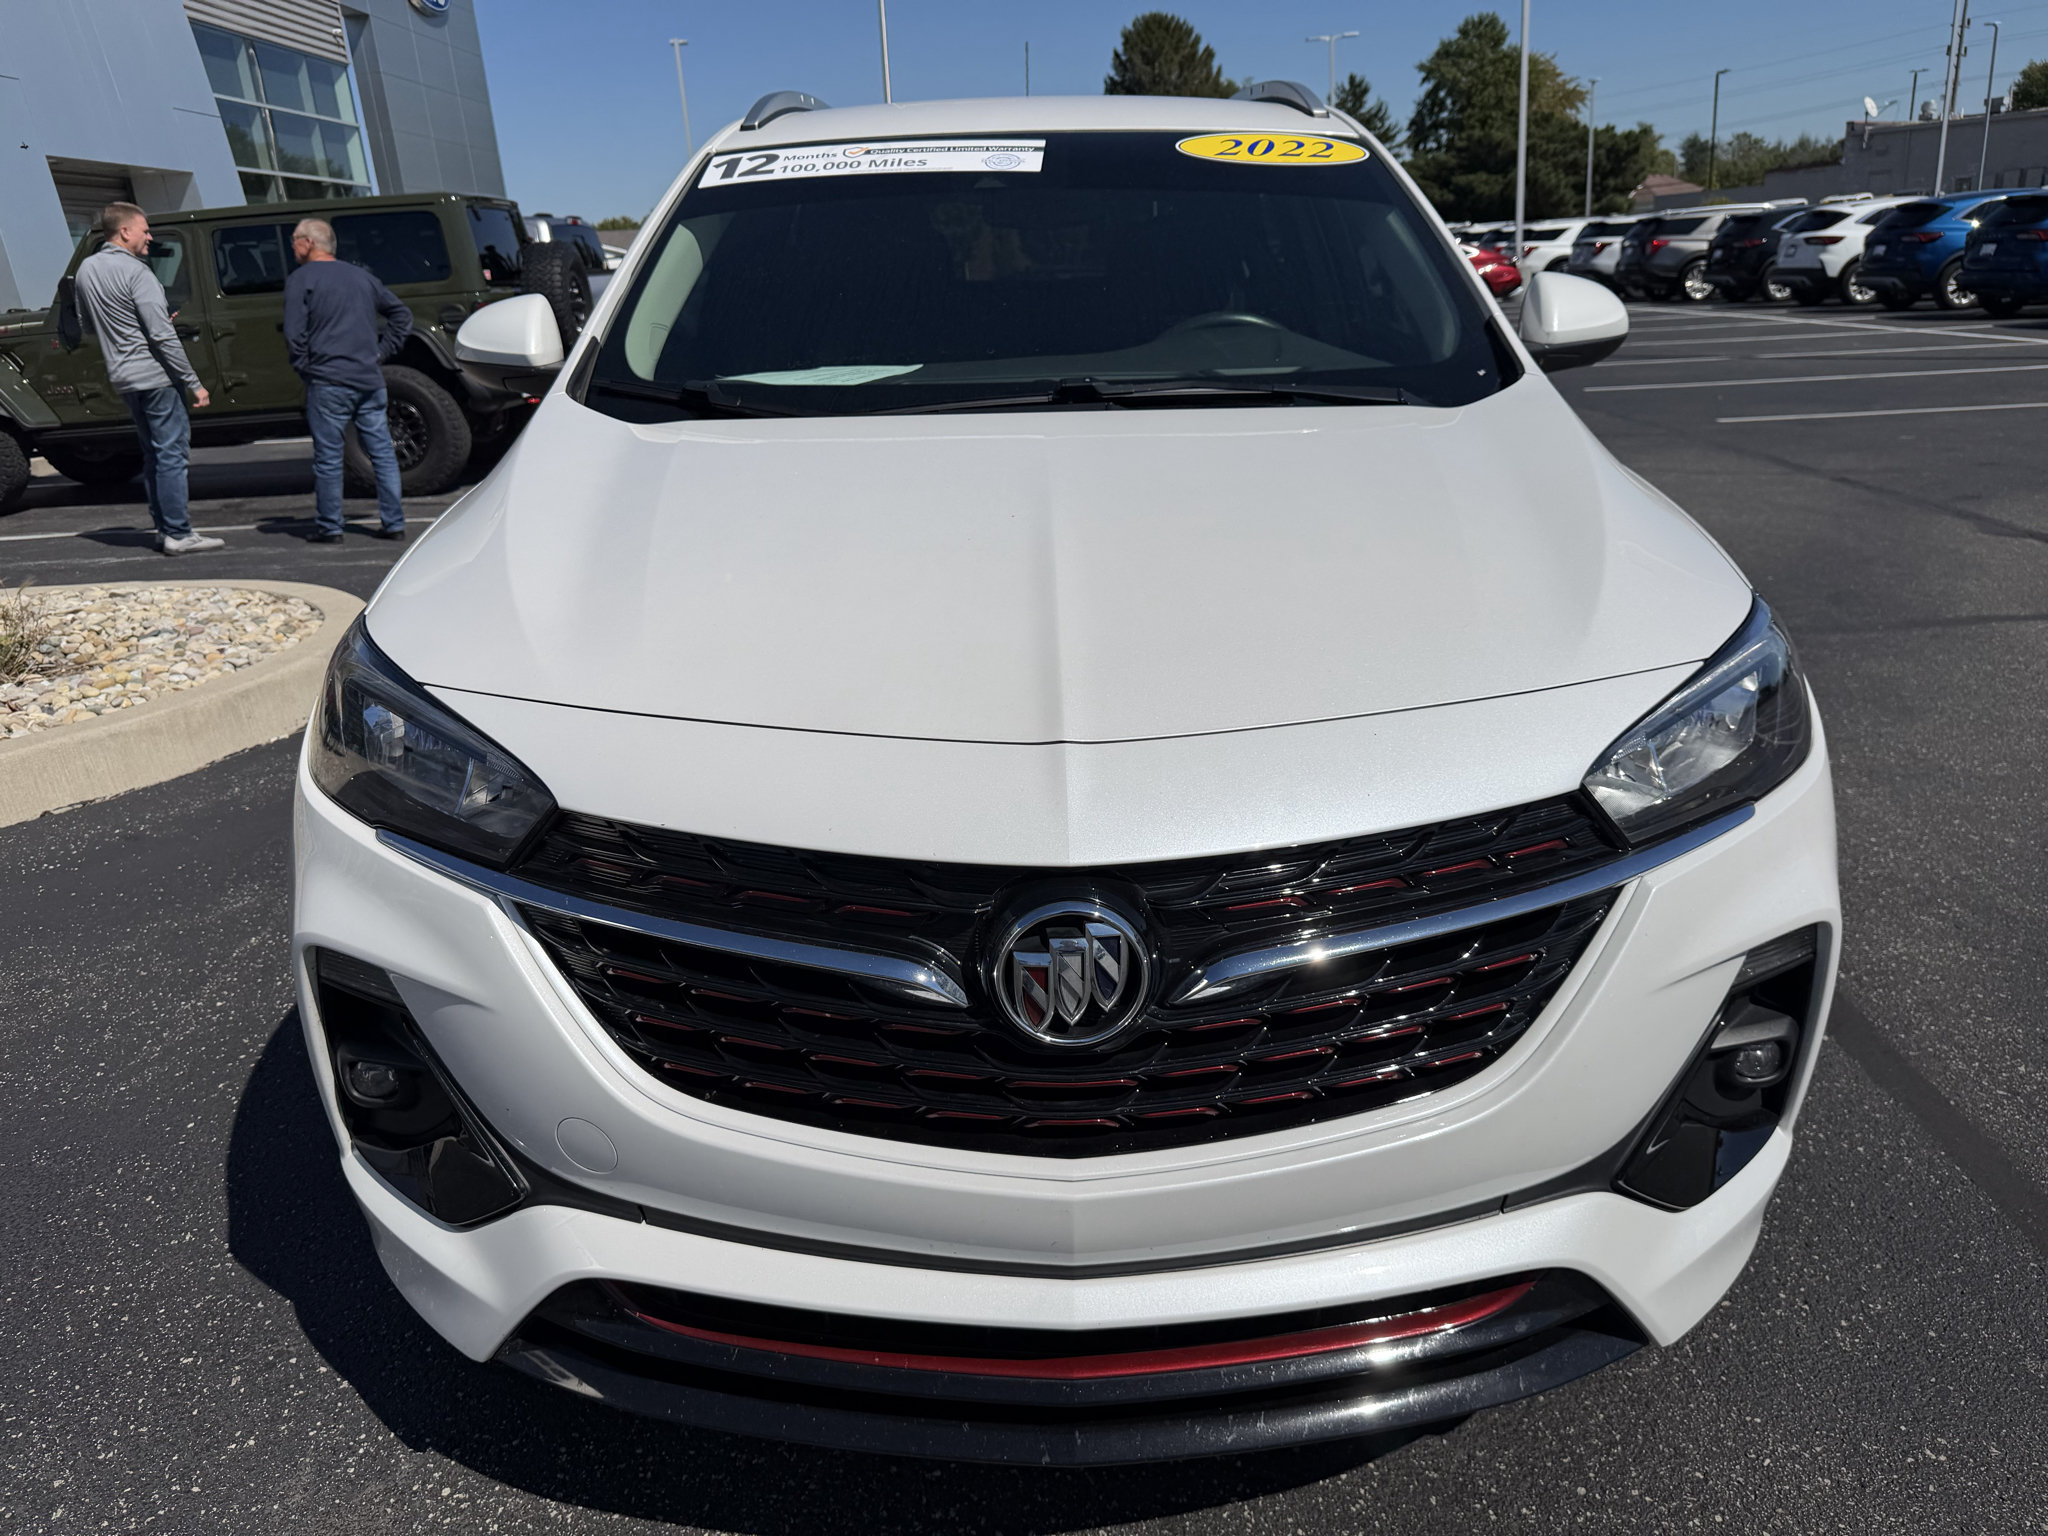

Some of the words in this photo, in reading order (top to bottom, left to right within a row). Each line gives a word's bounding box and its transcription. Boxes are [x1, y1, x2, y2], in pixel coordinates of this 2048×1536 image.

[783, 152, 837, 161] Months
[1214, 139, 1334, 158] 2022
[713, 153, 780, 180] 12
[780, 161, 861, 174] 100,000
[868, 158, 928, 168] Miles
